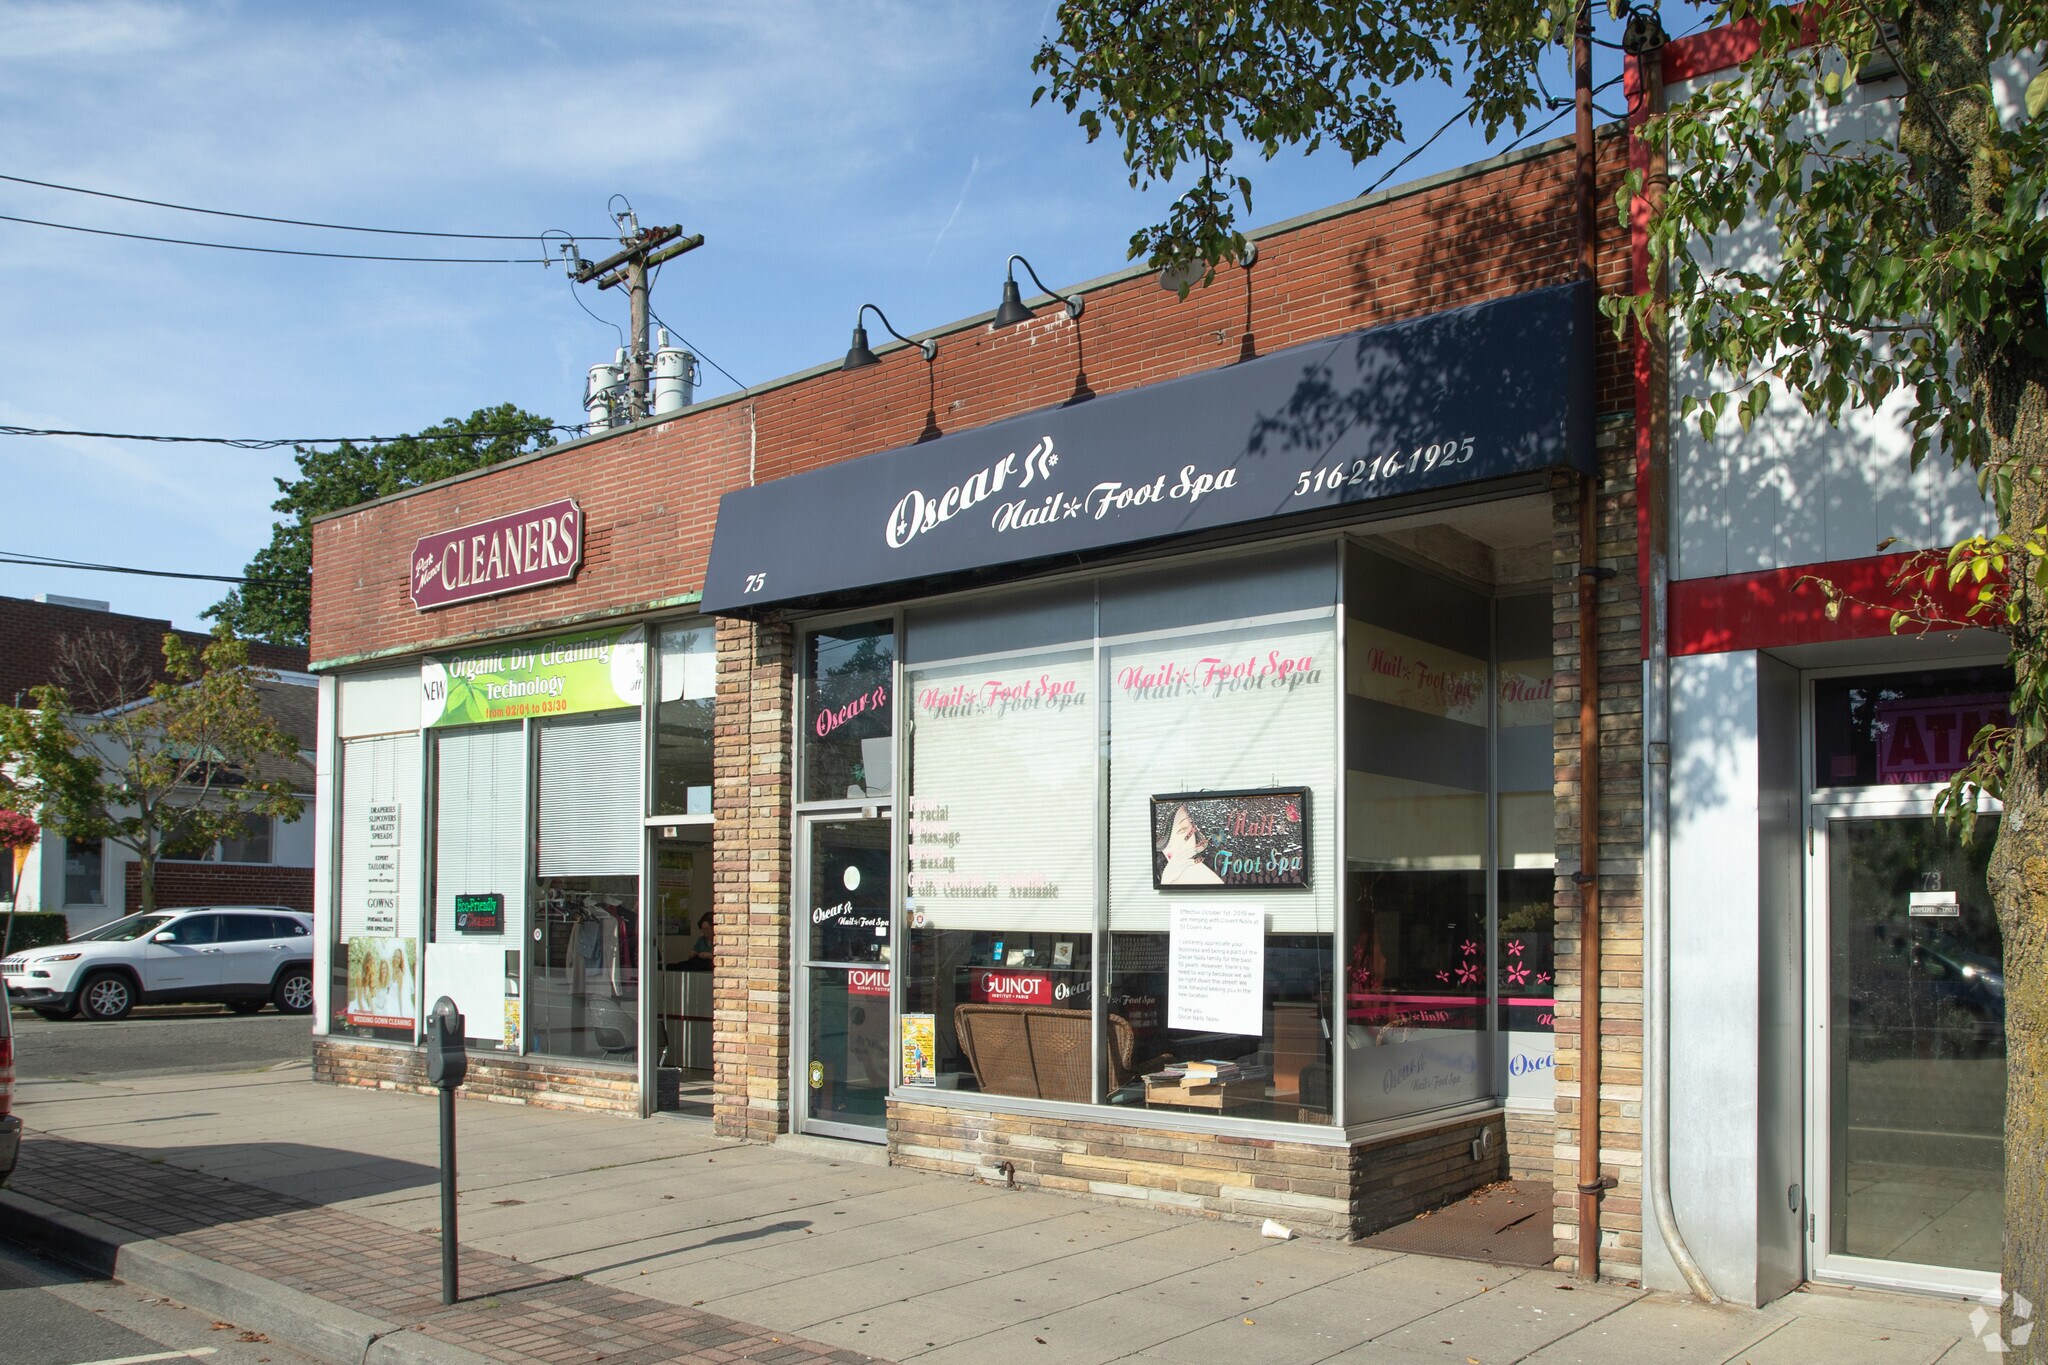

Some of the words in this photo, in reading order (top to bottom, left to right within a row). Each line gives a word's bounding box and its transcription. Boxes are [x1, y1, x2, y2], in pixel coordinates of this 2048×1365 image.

[1294, 437, 1475, 496] 516-216-1925
[885, 453, 1017, 548] Oscar
[992, 493, 1063, 533] Nail
[1085, 474, 1165, 521] Foot
[1169, 464, 1237, 504] Spa
[442, 512, 574, 590] CLEANERS
[415, 553, 434, 578] Park
[416, 561, 442, 594] Manor
[744, 572, 767, 594] 75
[449, 652, 505, 681] Organic
[510, 648, 536, 673] Dry
[540, 635, 610, 666] Cleaning
[1118, 662, 1174, 691] Nail
[1194, 656, 1256, 688] Foot
[1262, 650, 1313, 680] Spa
[1368, 647, 1402, 678] Nail
[1412, 660, 1445, 692] Foot
[1446, 671, 1470, 698] Spa
[424, 681, 446, 701] NEW
[486, 674, 566, 700] Technology
[918, 684, 964, 710] Nail
[980, 680, 1030, 708] Foot
[1034, 674, 1078, 700] Spa
[1502, 676, 1552, 702] Nail
[486, 708, 504, 718] from
[506, 703, 530, 716] 02/01
[532, 704, 540, 714] to
[542, 699, 567, 713] 03/30
[816, 693, 870, 736] Oscar
[1885, 770, 1951, 784] AVAILAB
[369, 814, 396, 822] SLIPCOVERS
[370, 806, 396, 814] DRAPERIES
[1227, 809, 1274, 837] Nail
[372, 832, 393, 840] SPREADS
[1214, 850, 1262, 876] Foot
[1266, 848, 1302, 876] Spa
[1921, 872, 1942, 891] 73
[368, 898, 394, 908] GOWNS
[457, 897, 496, 914] Eco-Friendly
[812, 902, 843, 924] Oscar
[860, 917, 875, 926] Foot
[876, 918, 889, 928] Spa
[981, 972, 1041, 994] GUINOT
[389, 1018, 411, 1026] CLEANING
[1510, 1054, 1558, 1077] Osca
